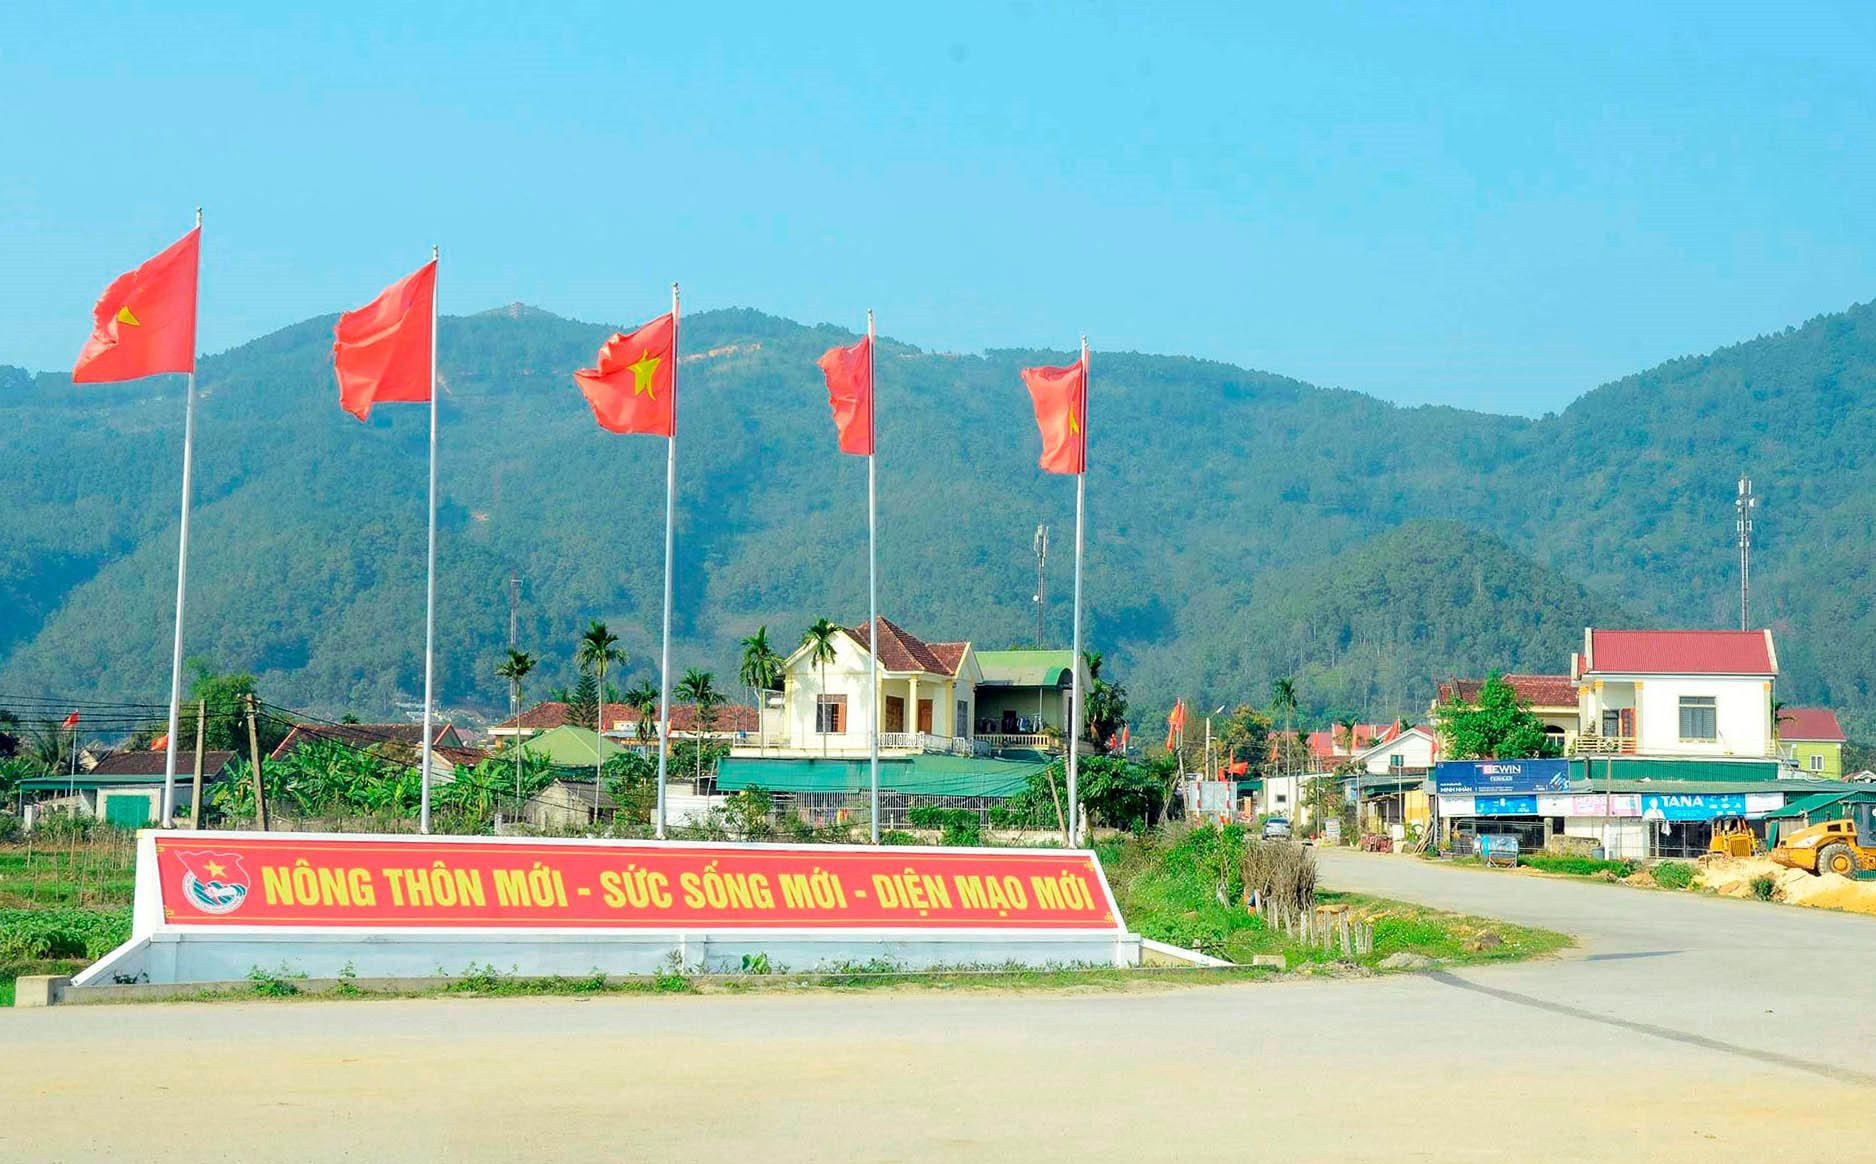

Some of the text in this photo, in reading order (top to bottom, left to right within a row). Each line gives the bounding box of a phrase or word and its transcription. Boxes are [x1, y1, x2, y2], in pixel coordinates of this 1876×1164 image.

[1661, 795, 1704, 807] TANA
[262, 859, 374, 906] NÔNG
[383, 860, 485, 906] THÔN
[493, 862, 567, 907] MỚI
[601, 863, 672, 909] SỨC
[680, 860, 773, 909] SỐNG
[779, 865, 846, 909] MỚI
[873, 868, 951, 916] DIỆN
[955, 874, 1028, 917] MẠO
[1031, 869, 1094, 910] MỚI
